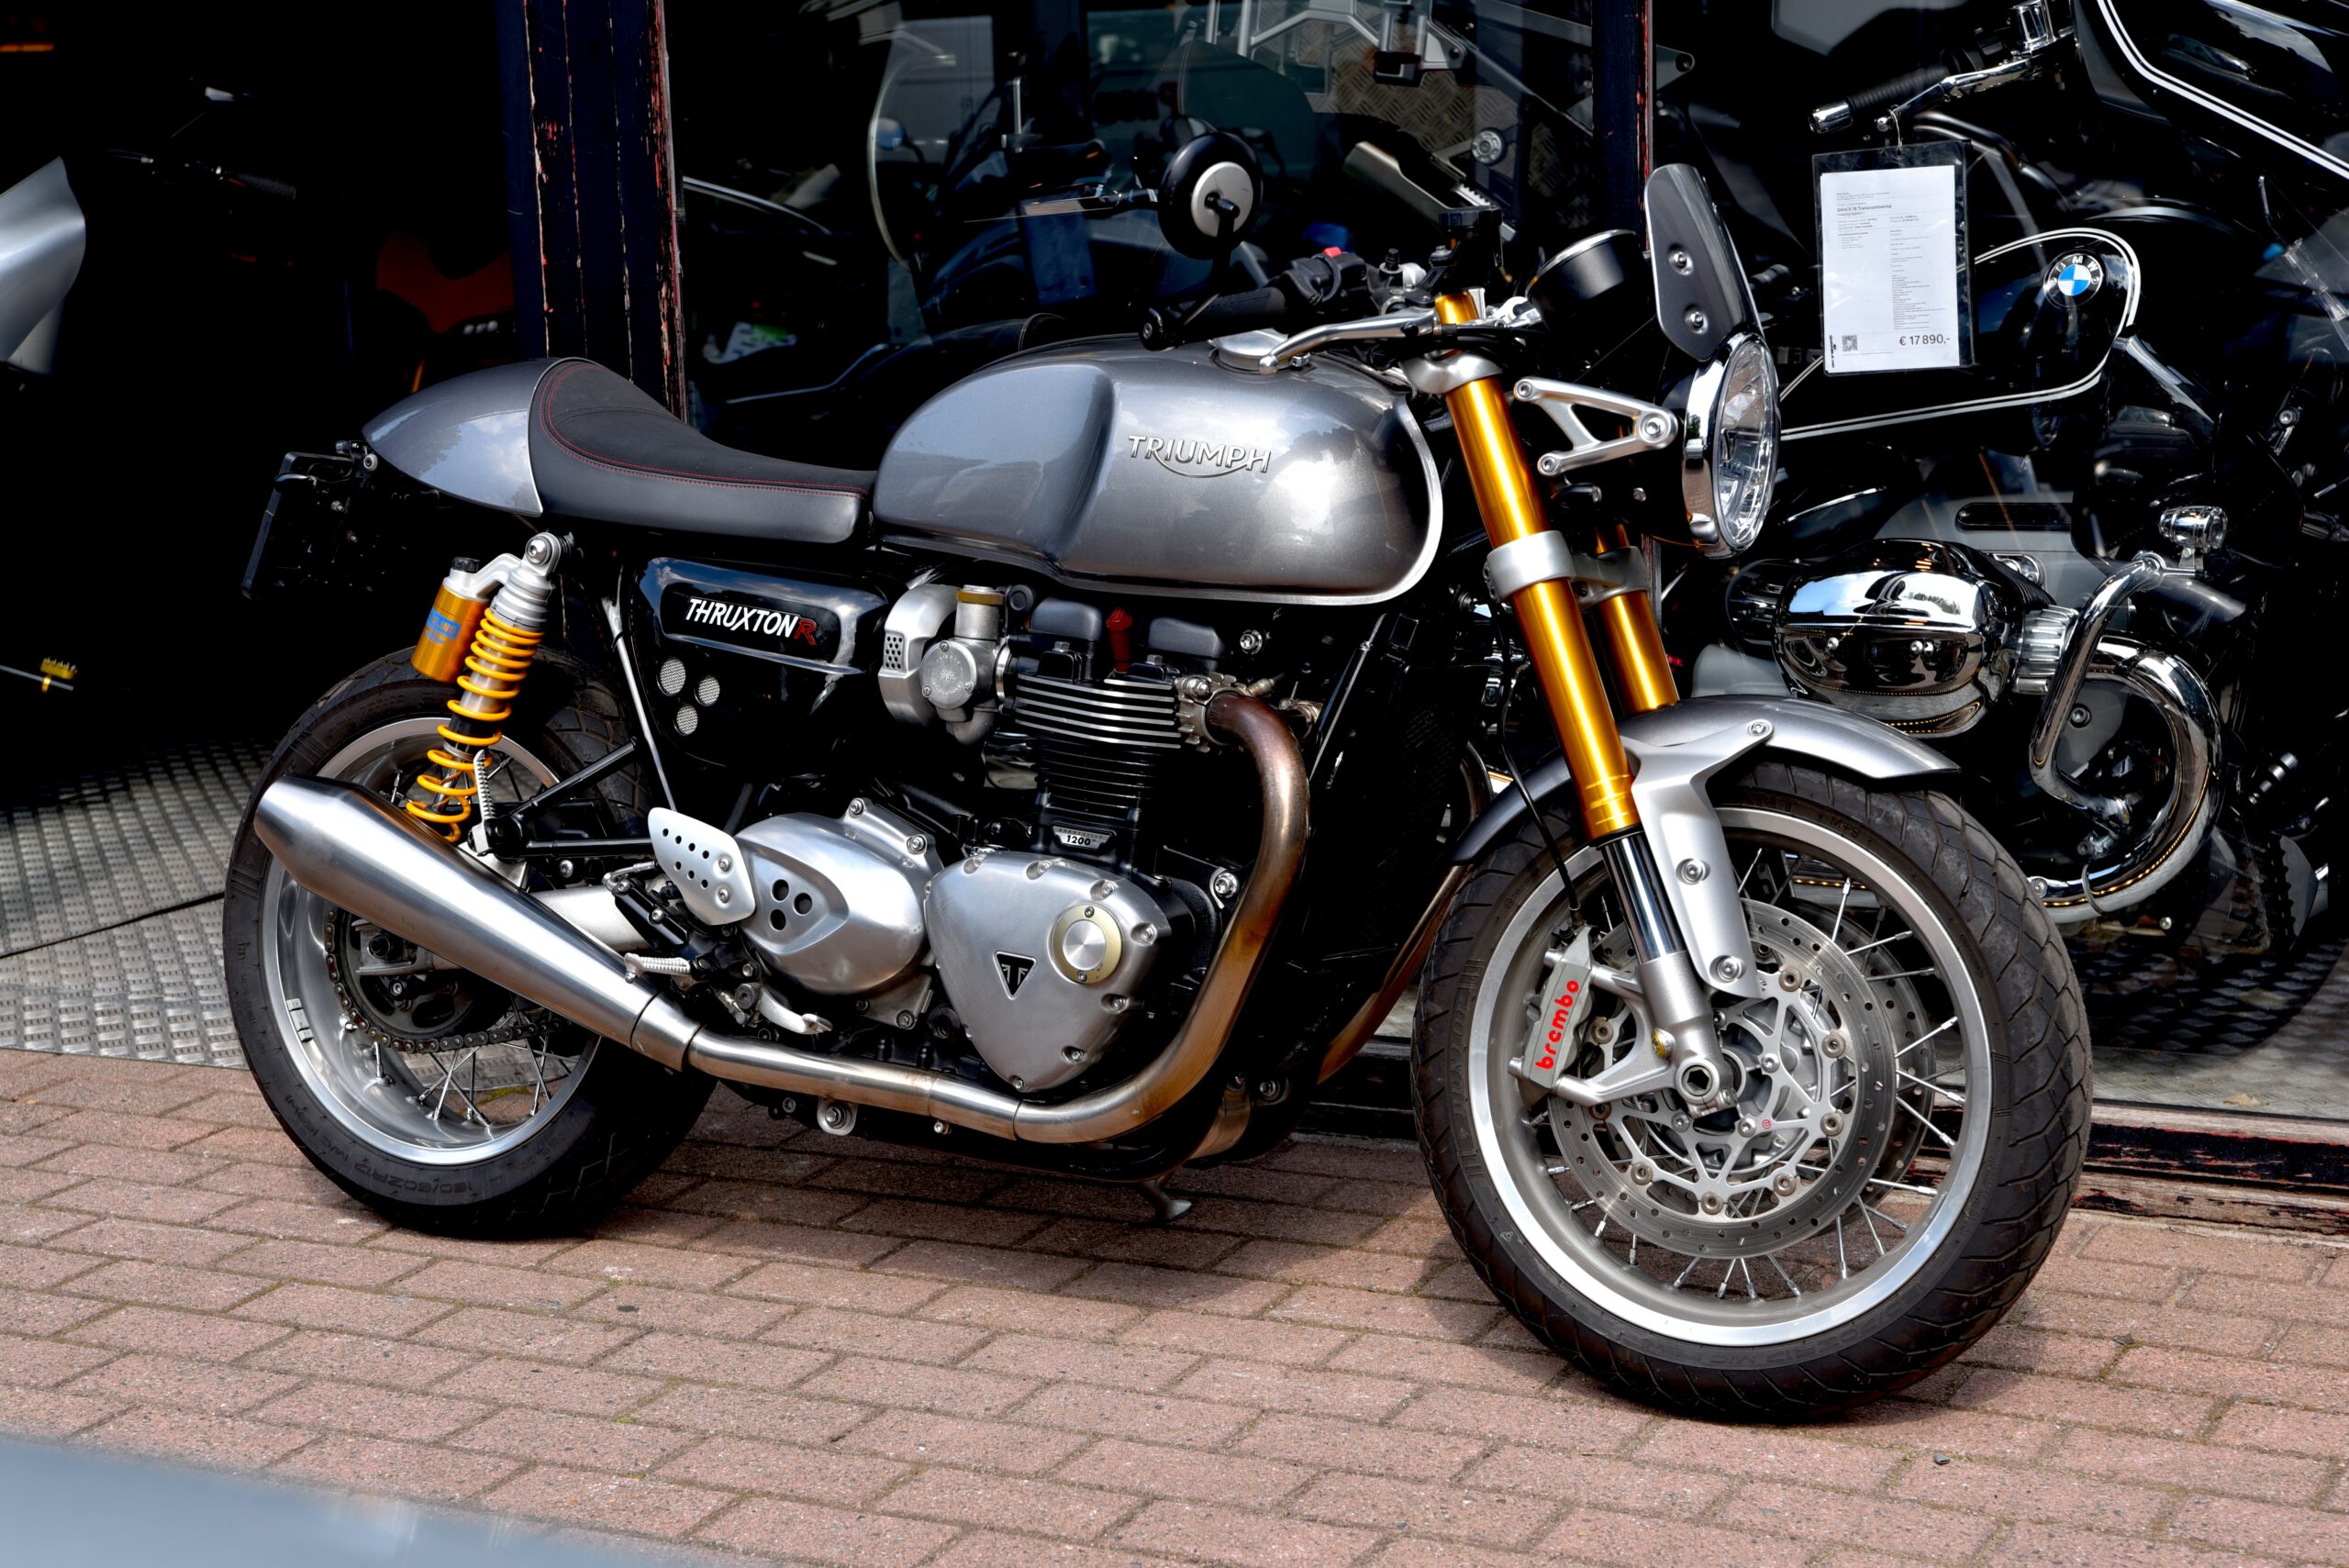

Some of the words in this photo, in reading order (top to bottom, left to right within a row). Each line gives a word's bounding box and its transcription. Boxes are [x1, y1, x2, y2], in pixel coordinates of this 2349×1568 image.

[2055, 255, 2099, 273] BMW
[1899, 336, 1907, 346] €
[1129, 435, 1272, 474] TRIUMPH
[685, 598, 799, 639] THRUXTON
[1066, 835, 1091, 846] 1200
[1534, 979, 1580, 1071] brembo
